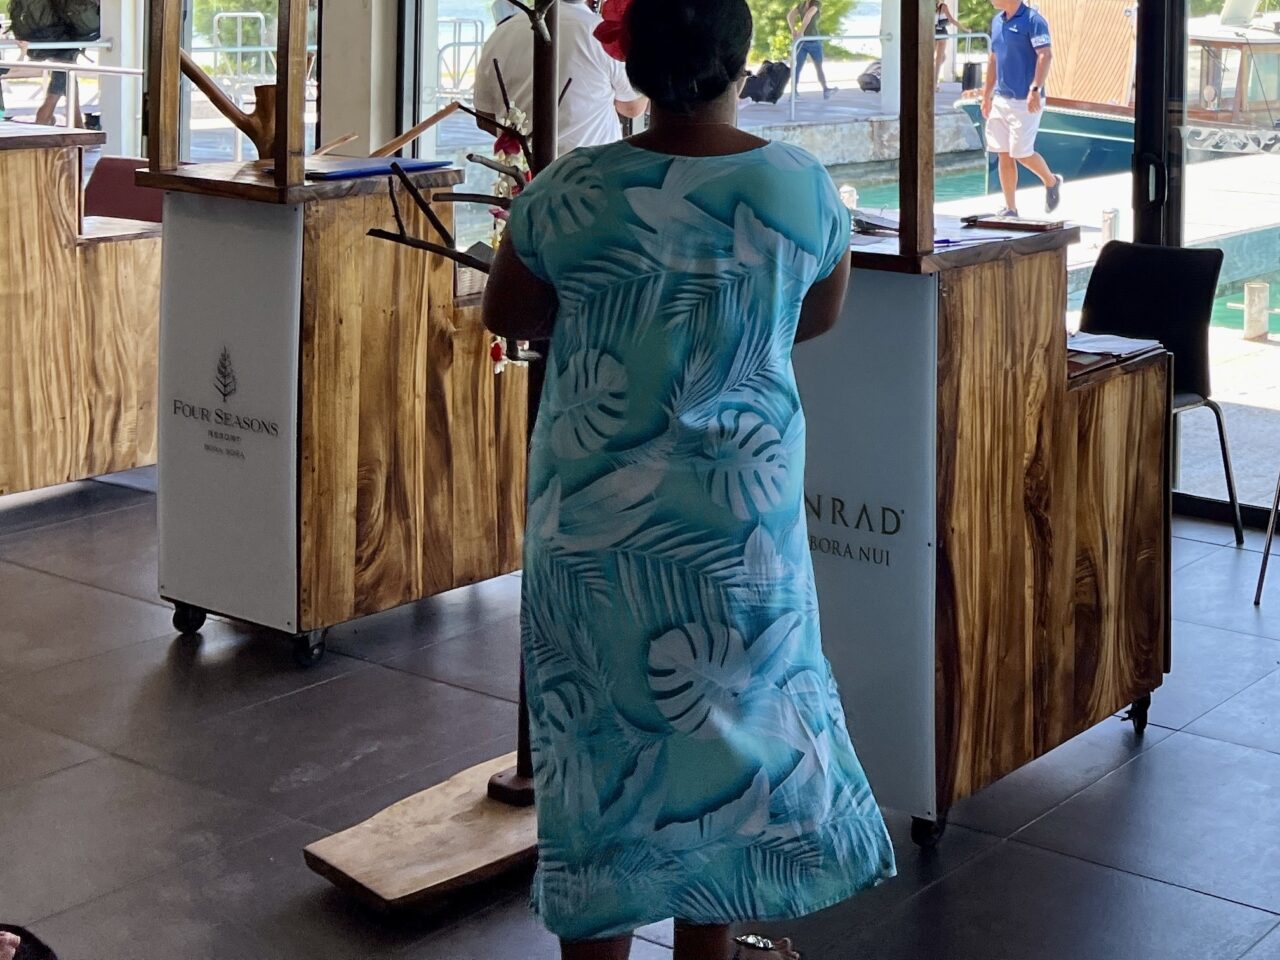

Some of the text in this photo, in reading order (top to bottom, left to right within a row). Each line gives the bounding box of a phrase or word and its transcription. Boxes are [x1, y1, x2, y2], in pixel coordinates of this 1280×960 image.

[173, 399, 279, 437] FOUR SEASONS
[804, 494, 901, 535] NRAD
[809, 535, 890, 566] BORA NUI
